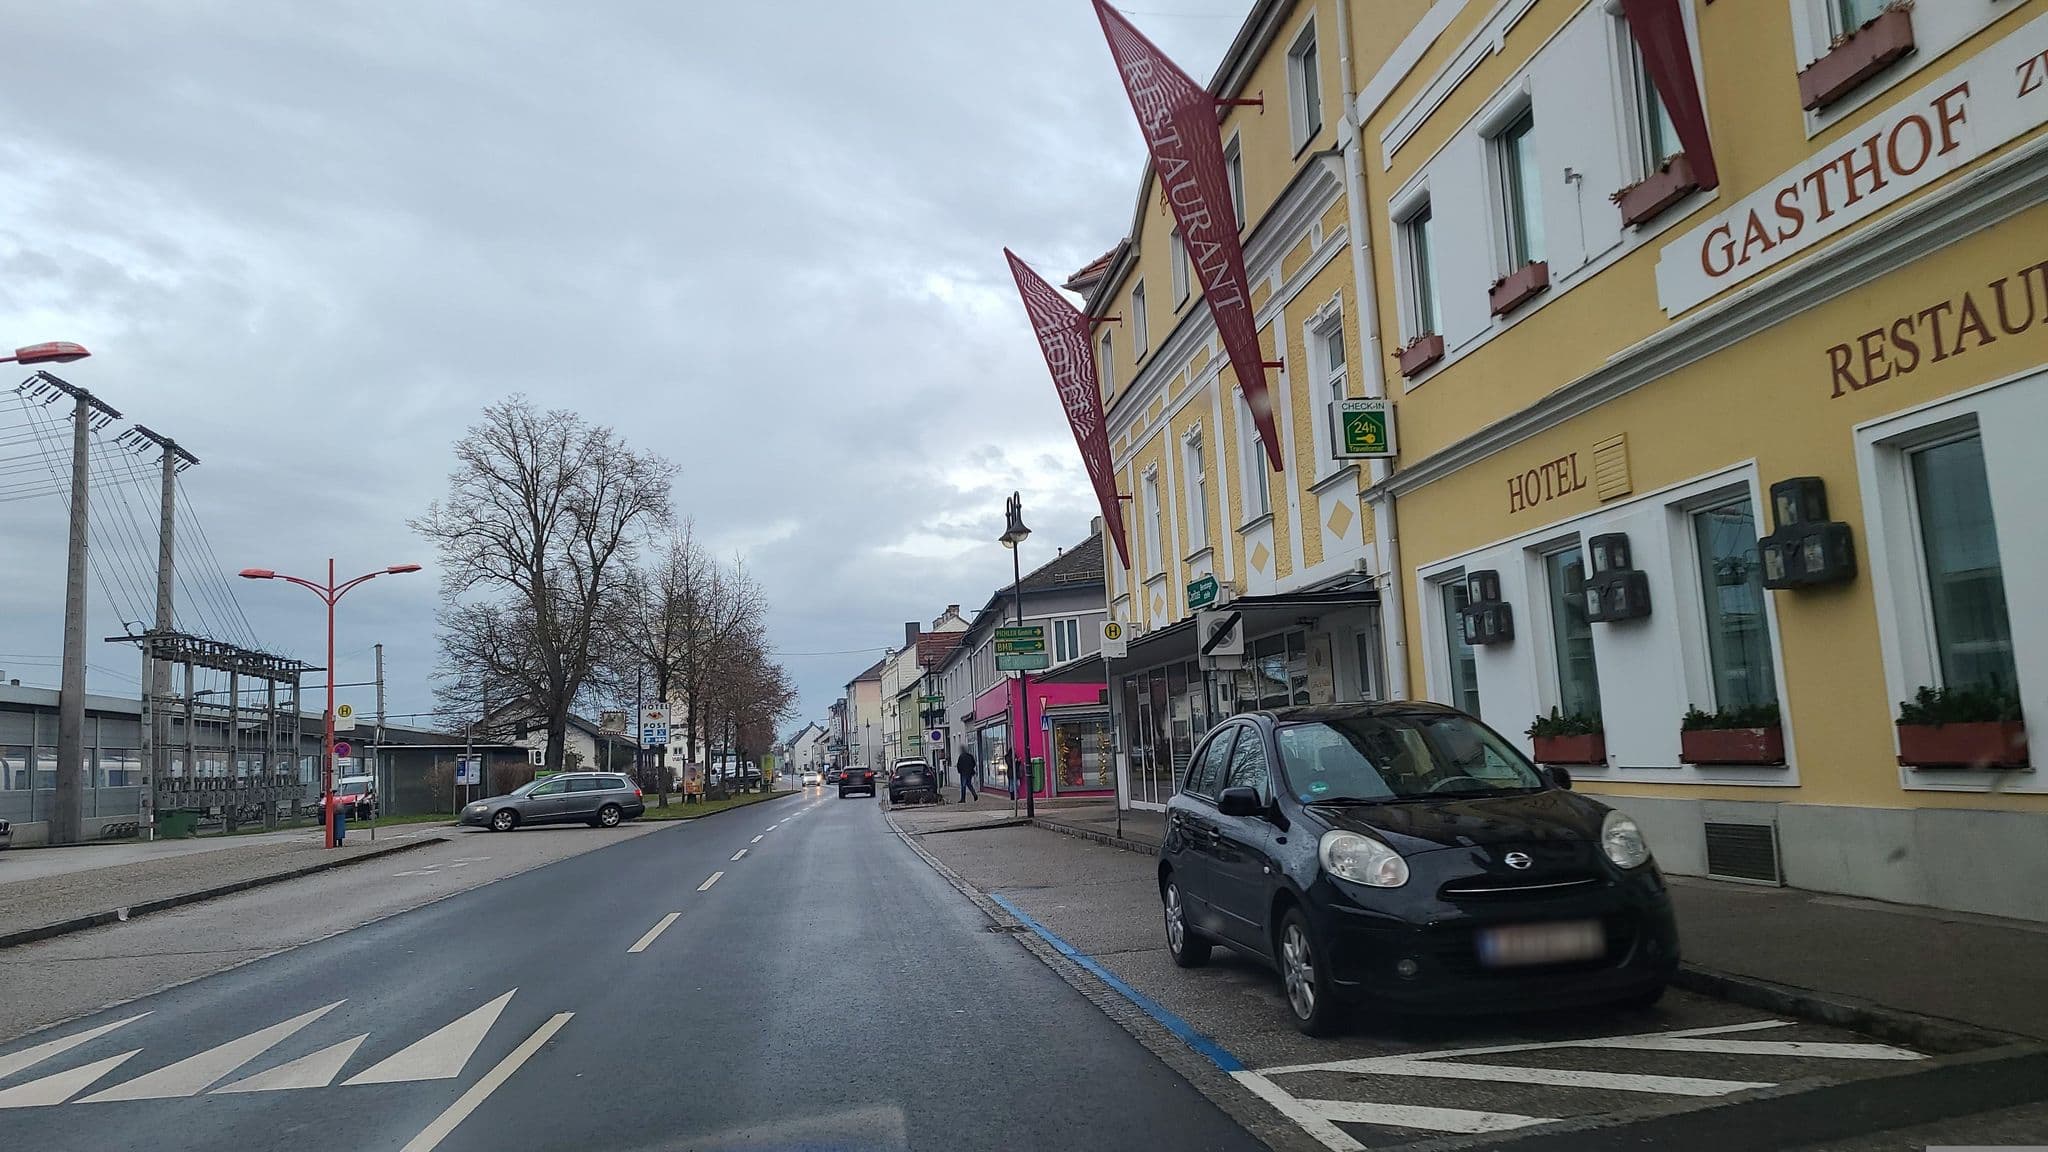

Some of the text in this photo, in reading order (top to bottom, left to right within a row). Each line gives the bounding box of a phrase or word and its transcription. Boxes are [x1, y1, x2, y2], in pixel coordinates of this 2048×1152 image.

[1123, 56, 1246, 312] RESTAURANT
[1701, 80, 1971, 278] GASTHOF
[1039, 322, 1090, 420] HOTEL
[1341, 402, 1385, 410] CHECK-IN
[1354, 421, 1377, 434] 24h
[1507, 452, 1588, 514] HOTEL
[641, 703, 669, 711] HOTEL
